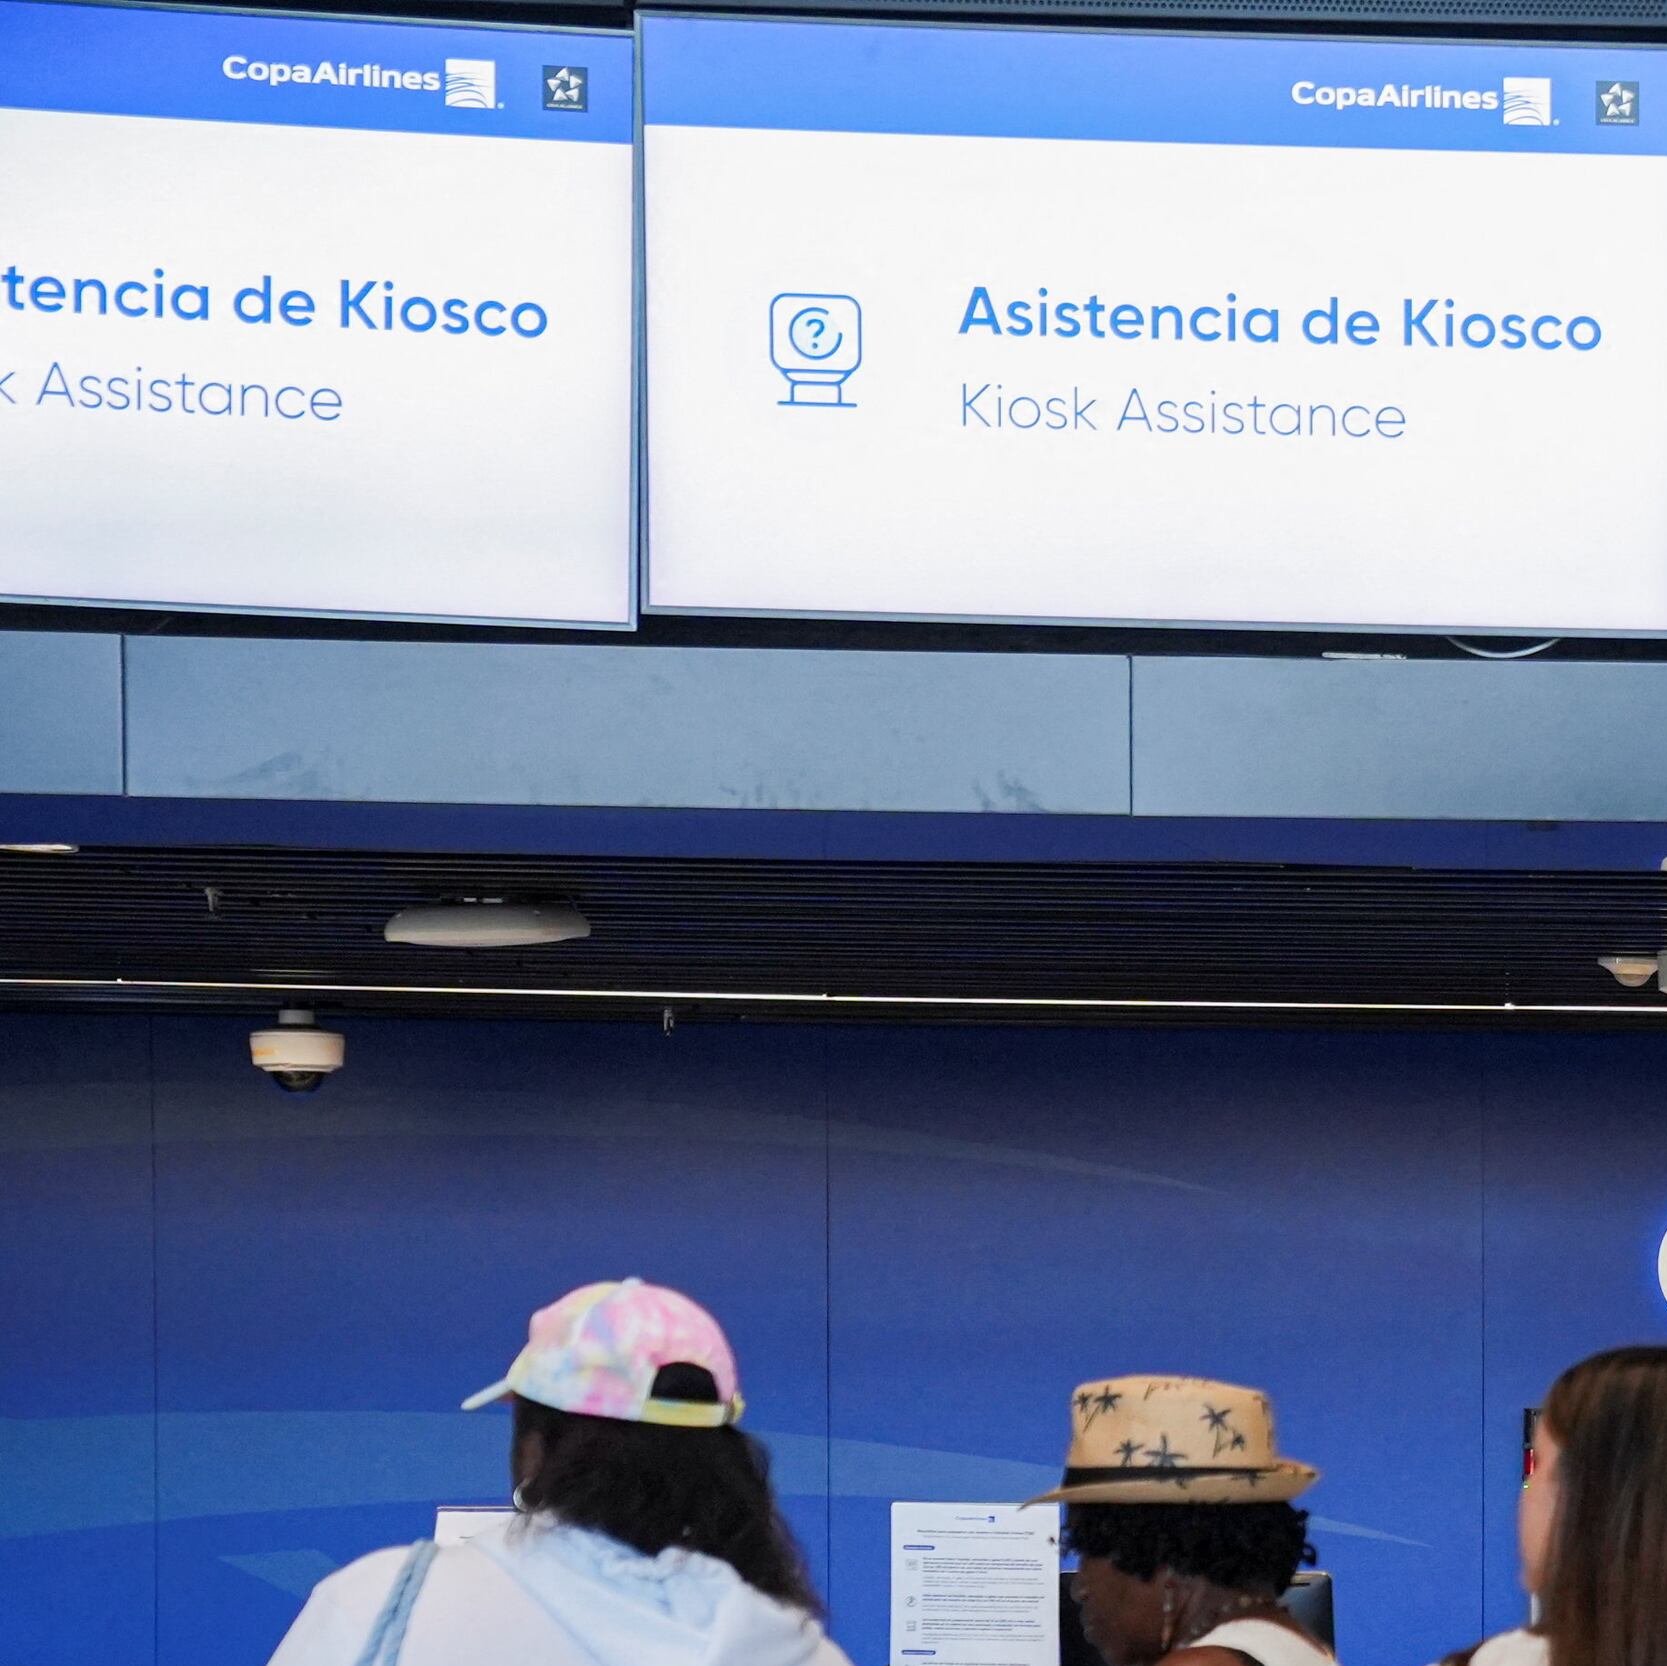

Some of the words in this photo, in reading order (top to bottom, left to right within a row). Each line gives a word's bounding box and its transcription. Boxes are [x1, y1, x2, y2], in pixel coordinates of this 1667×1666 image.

[222, 55, 441, 92] CopaAirlines
[1291, 81, 1498, 112] CopaAirlines
[233, 274, 315, 329] de
[340, 280, 547, 339] Kiosco
[959, 286, 1280, 344] Asistencia
[1302, 297, 1379, 346] de
[1403, 299, 1602, 351] Kiosco
[36, 363, 343, 422] Assistance
[962, 383, 1098, 432] Kiosk
[1117, 388, 1407, 439] Assistance
